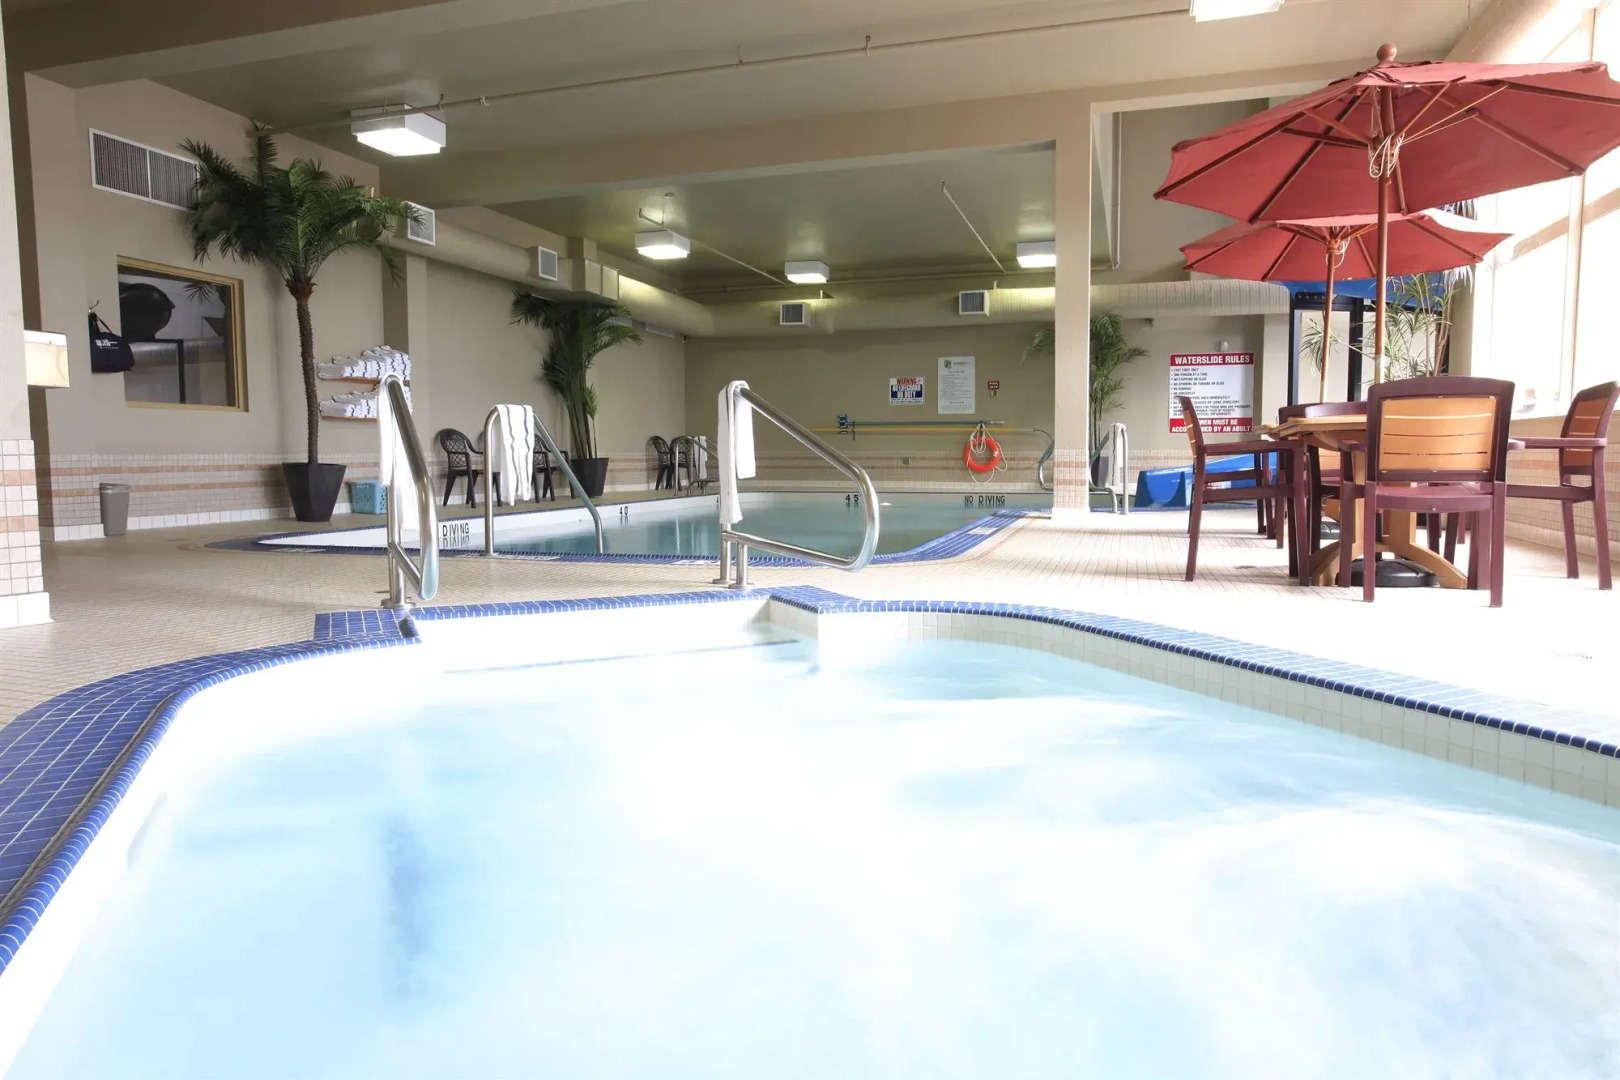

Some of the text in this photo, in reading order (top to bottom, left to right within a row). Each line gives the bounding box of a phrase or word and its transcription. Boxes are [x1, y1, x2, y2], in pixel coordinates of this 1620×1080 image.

[1174, 354, 1250, 364] WATERSLIDE RULES
[979, 495, 1005, 503] DIVING
[442, 523, 469, 536] DIVING
